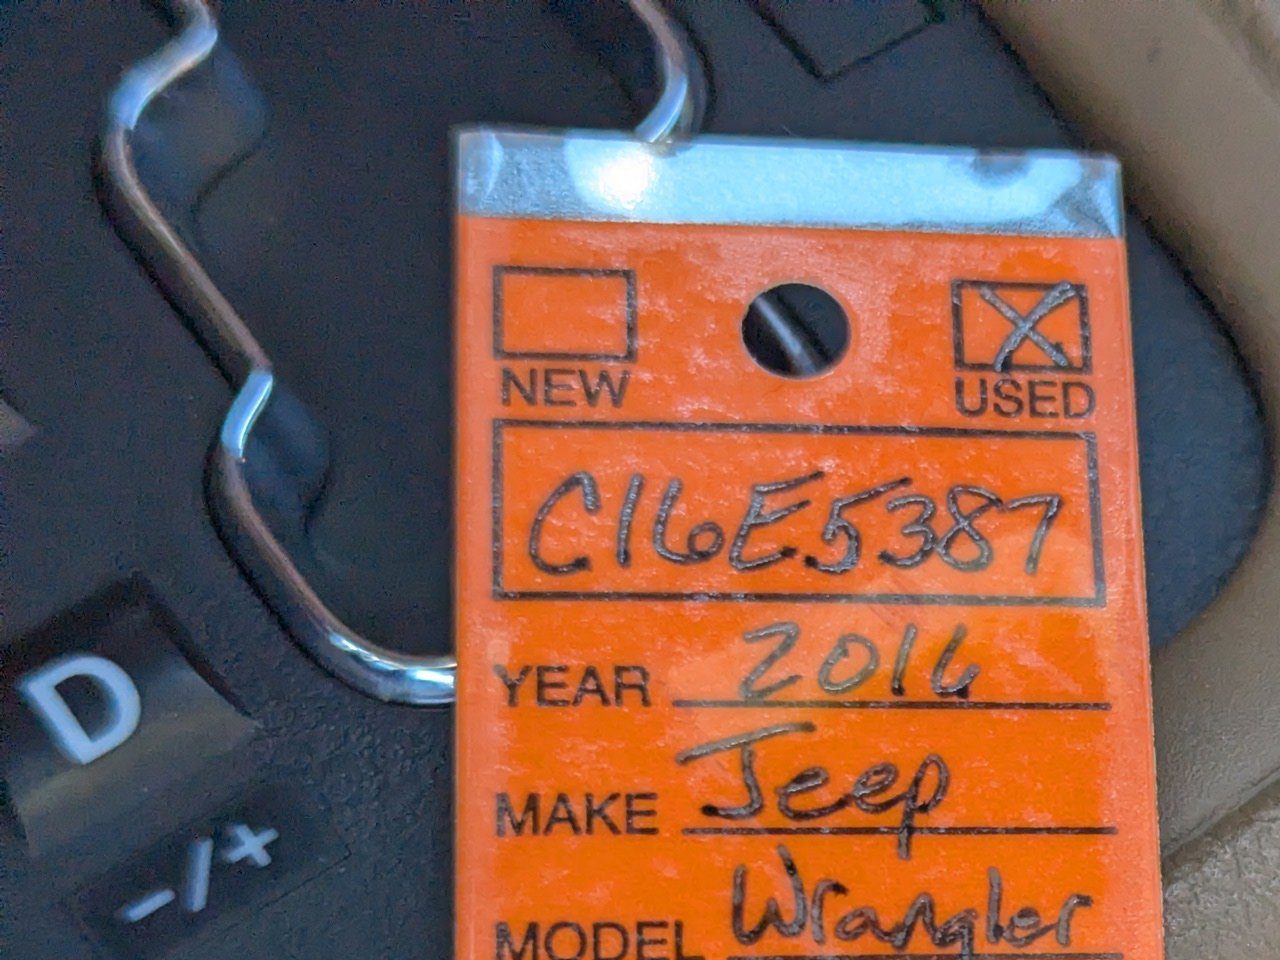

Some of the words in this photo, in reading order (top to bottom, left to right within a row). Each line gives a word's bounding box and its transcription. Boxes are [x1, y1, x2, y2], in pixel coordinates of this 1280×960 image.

[499, 367, 631, 408] NEW
[954, 378, 1096, 419] USED
[529, 470, 1064, 575] C16E5387
[493, 664, 651, 708] YEAR
[740, 621, 982, 701] 2016
[17, 654, 141, 765] D
[495, 791, 659, 837] MAKE
[676, 721, 950, 859] Jeep
